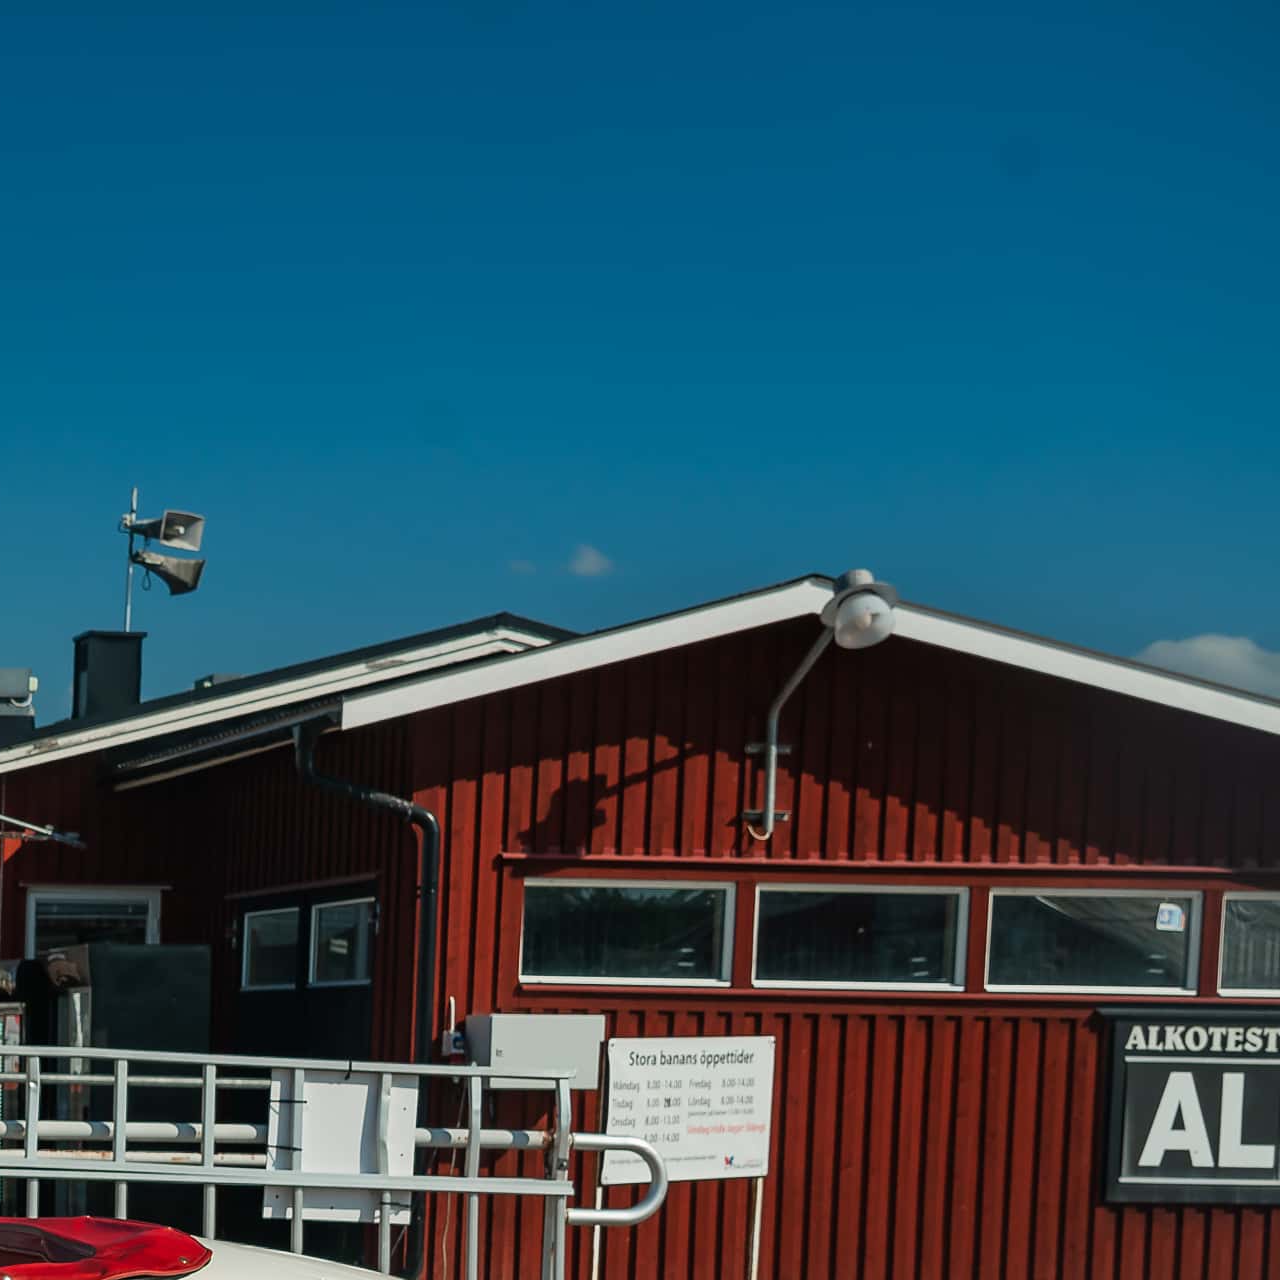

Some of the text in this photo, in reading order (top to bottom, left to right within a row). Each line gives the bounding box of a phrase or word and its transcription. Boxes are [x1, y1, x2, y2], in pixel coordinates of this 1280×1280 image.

[1124, 1024, 1280, 1053] ALKOTEST
[629, 1050, 755, 1068] Stora banans öppettider
[1137, 1071, 1276, 1169] AL
